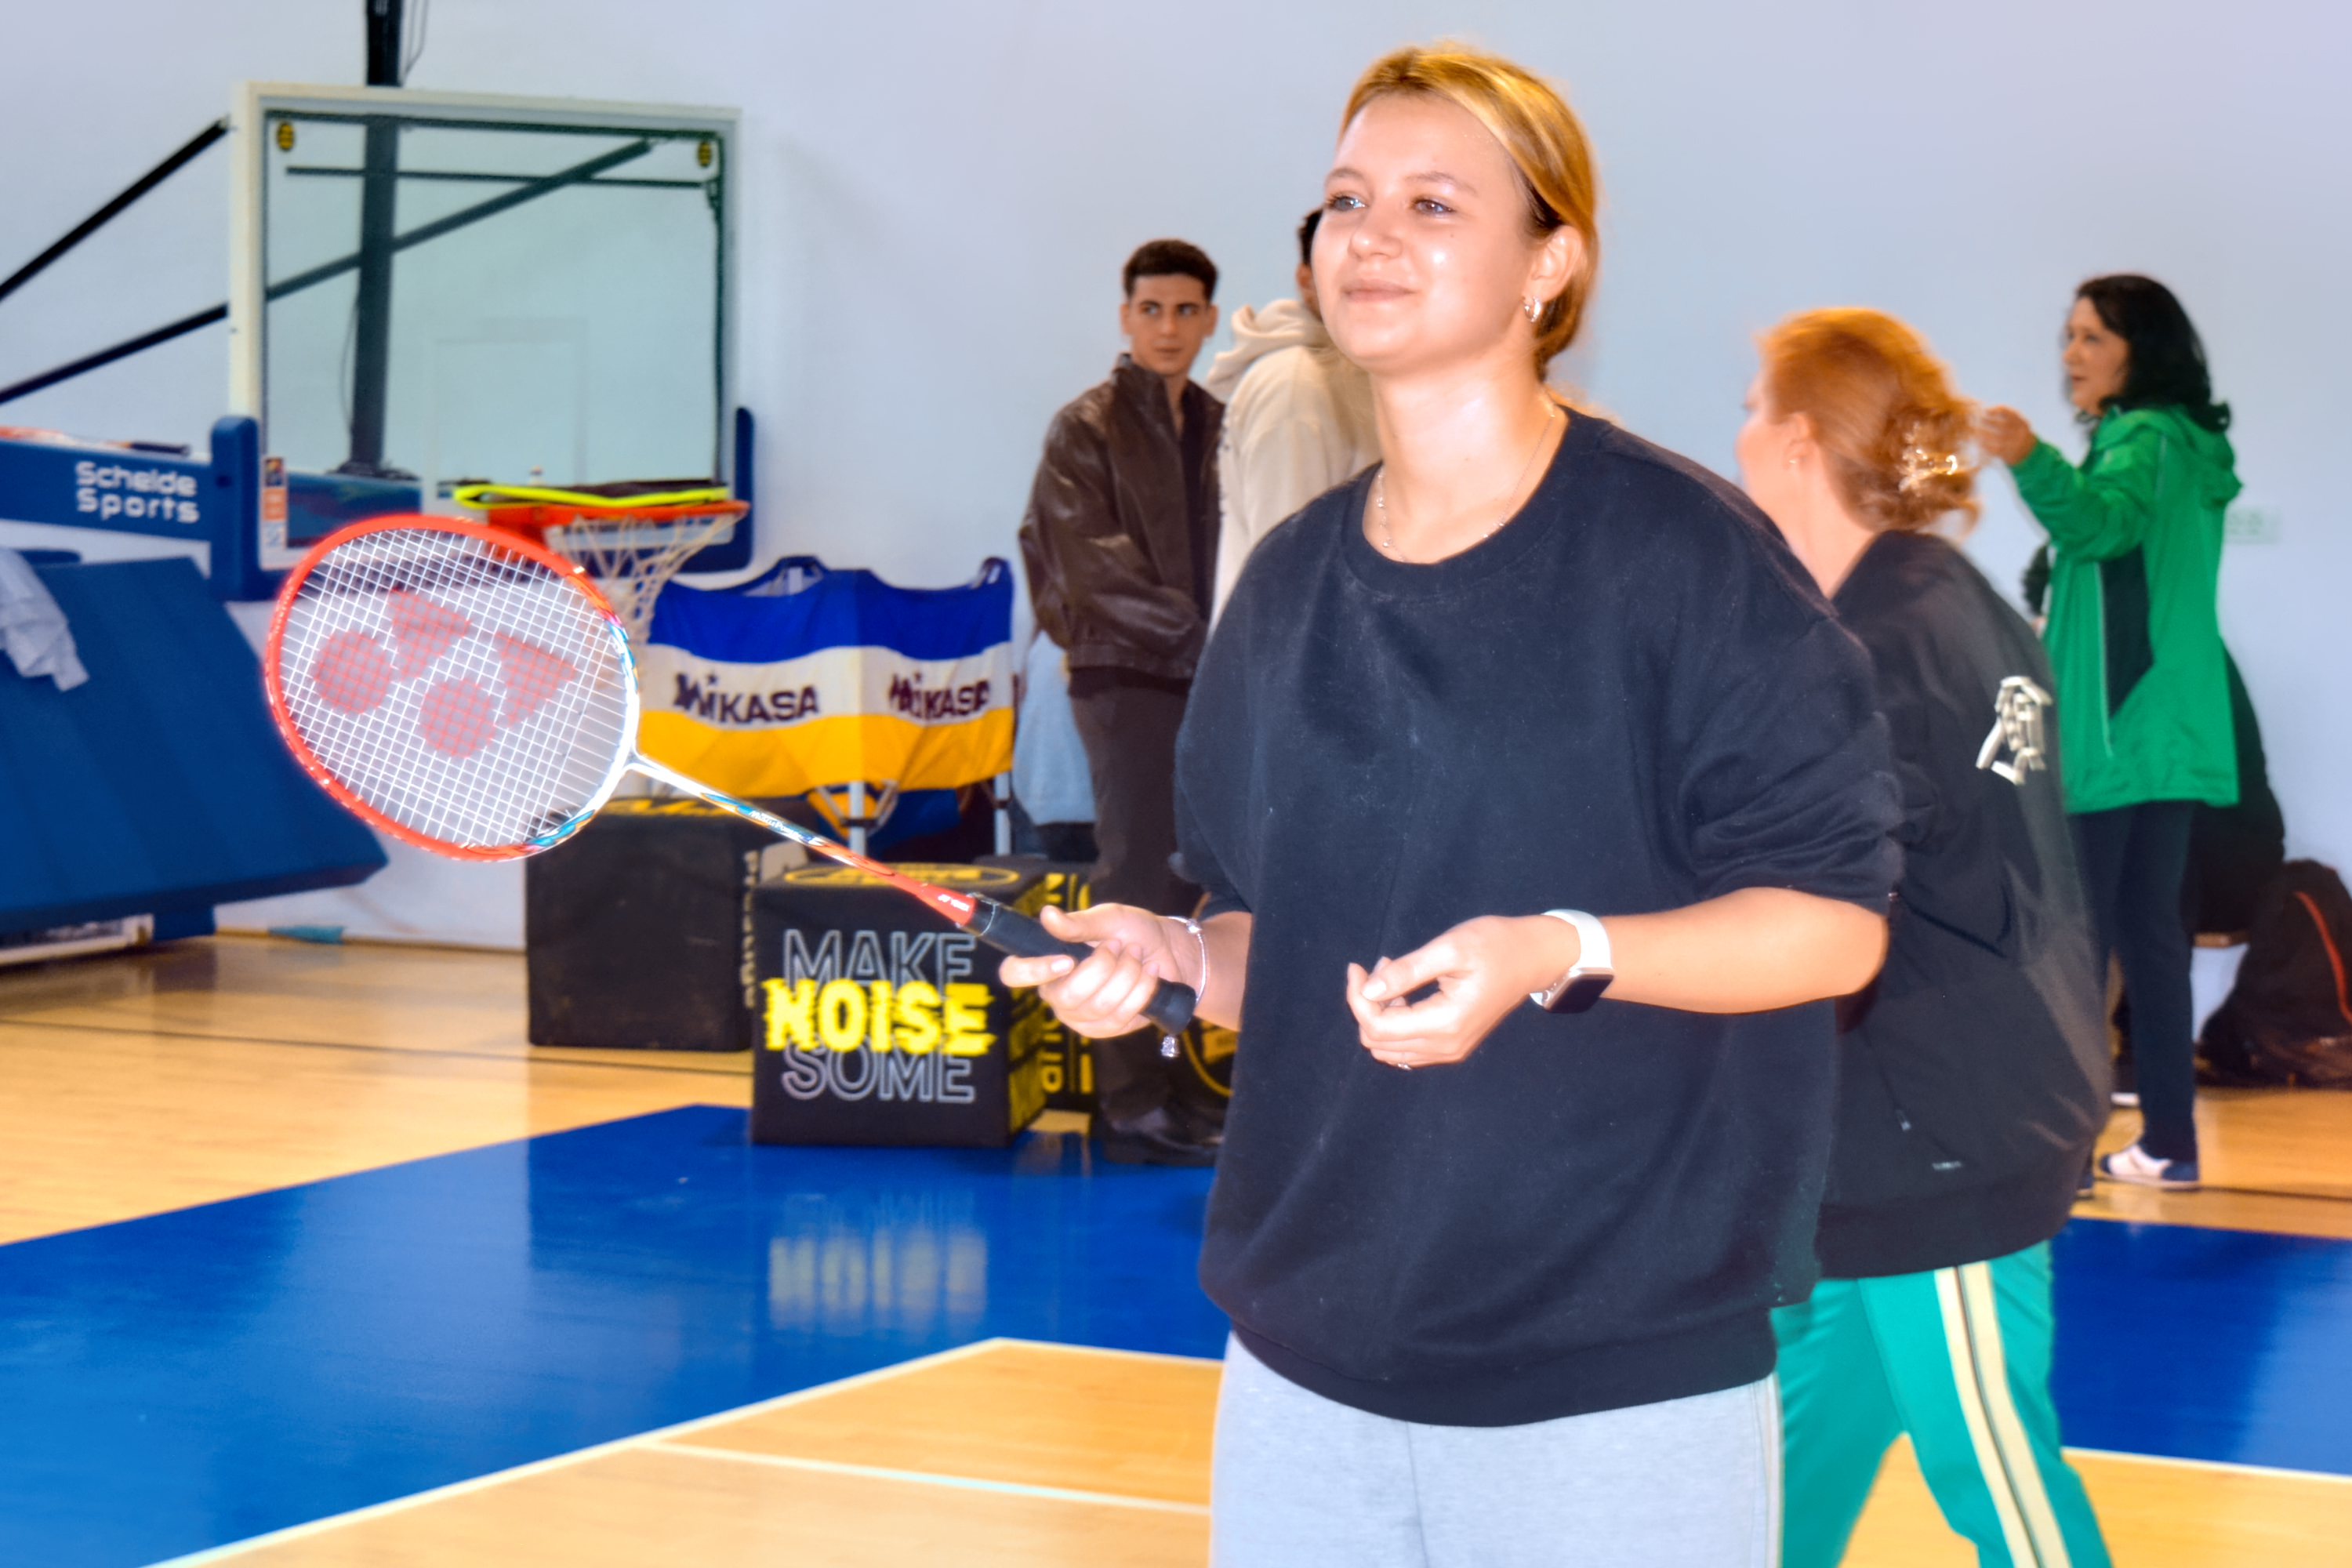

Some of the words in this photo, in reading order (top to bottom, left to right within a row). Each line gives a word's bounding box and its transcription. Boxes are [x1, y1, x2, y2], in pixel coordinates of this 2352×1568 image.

[75, 460, 198, 497] Schelde
[77, 487, 200, 524] Sports
[784, 928, 976, 989] MAKE
[762, 978, 996, 1055] NOISE
[781, 1044, 975, 1103] SOME
